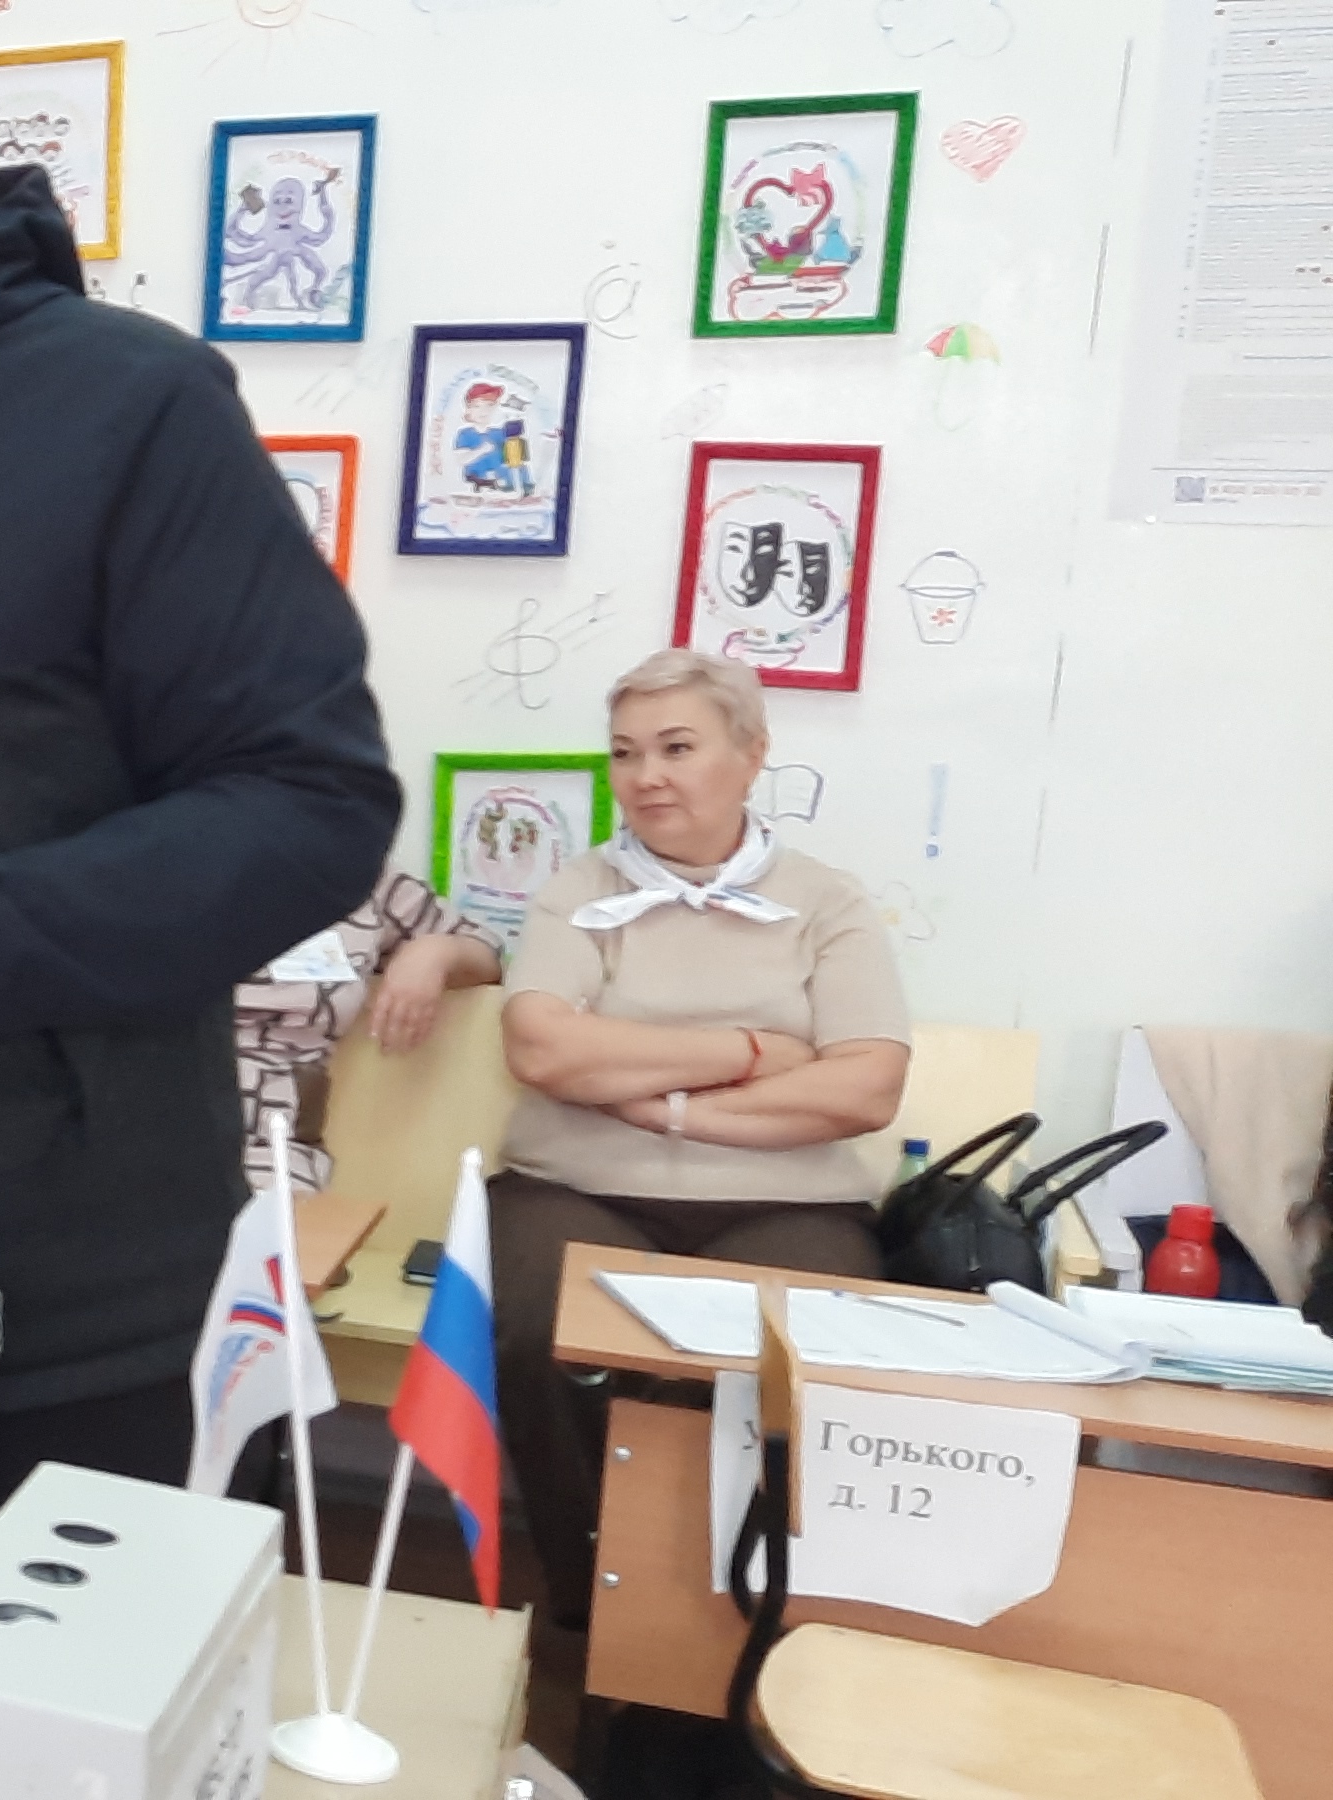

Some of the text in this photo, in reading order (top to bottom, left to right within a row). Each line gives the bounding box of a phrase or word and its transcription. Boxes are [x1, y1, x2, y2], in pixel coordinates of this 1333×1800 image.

[820, 1418, 1036, 1487] Горького,
[828, 1483, 933, 1520] д. 12
